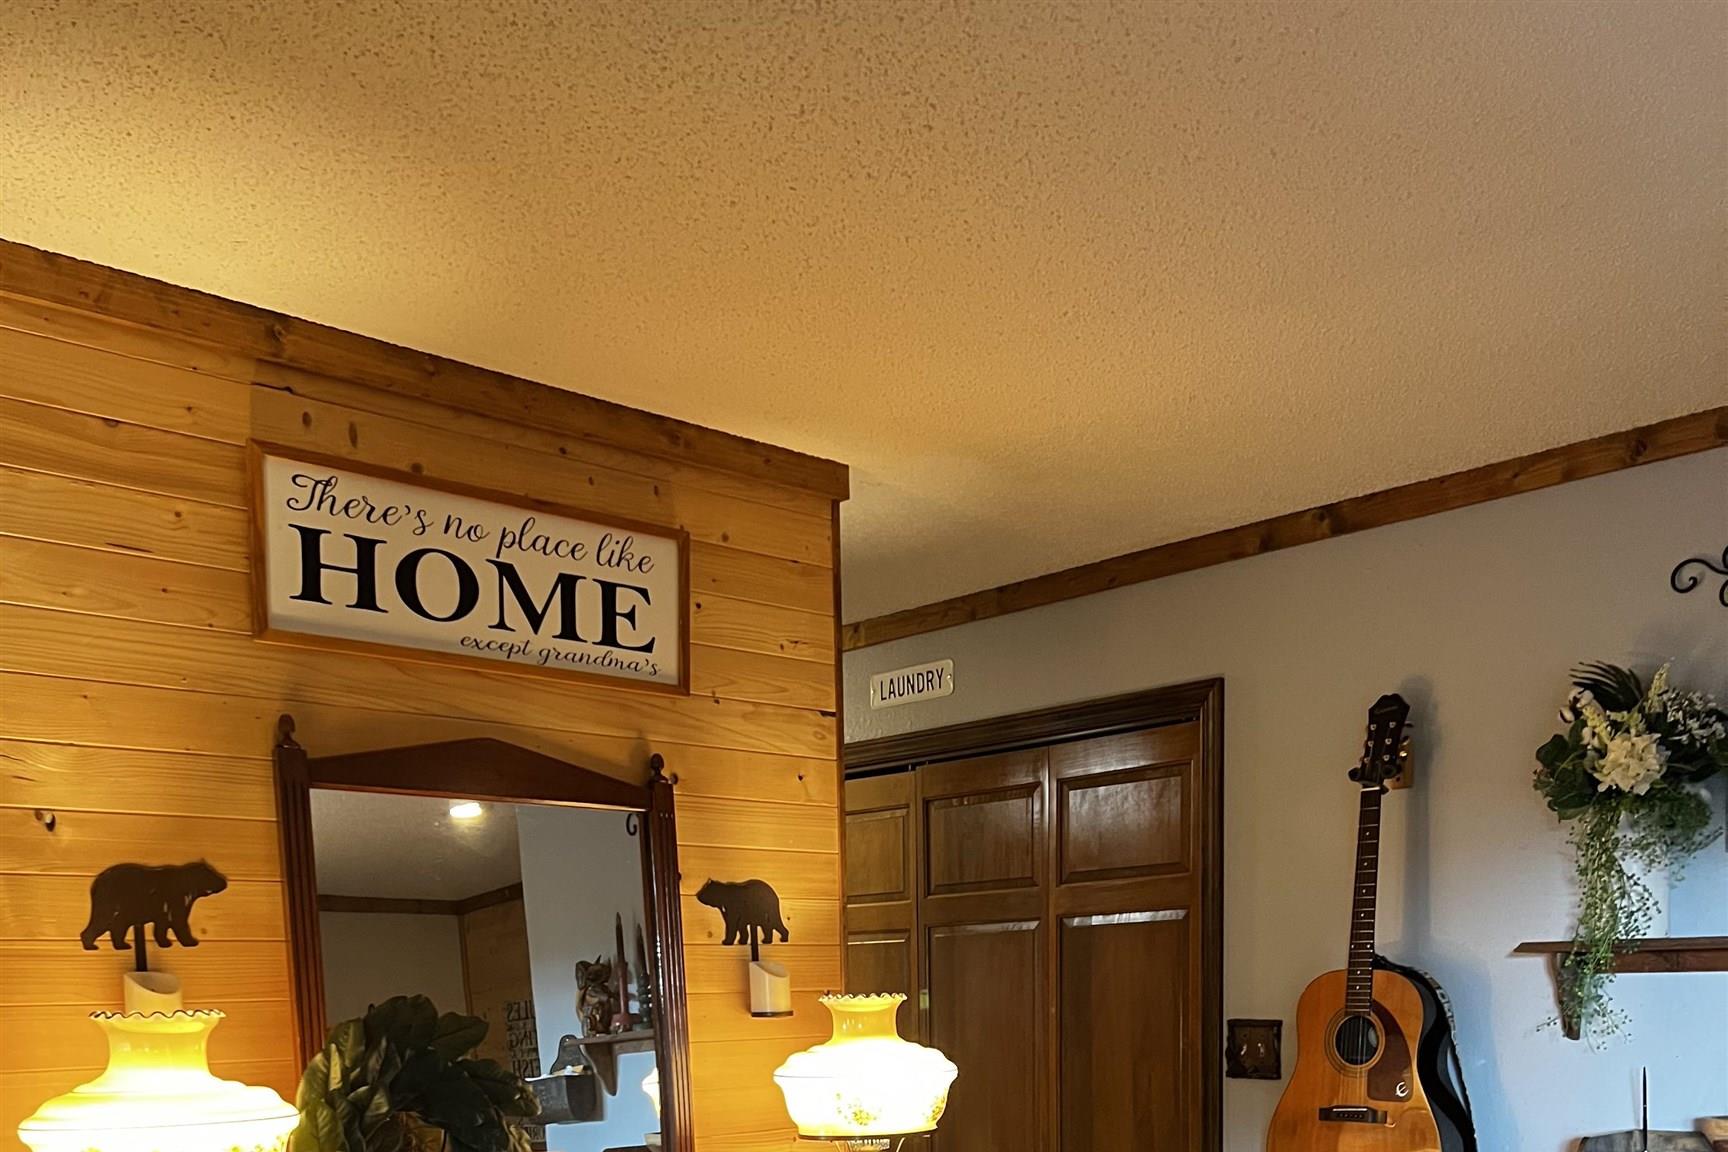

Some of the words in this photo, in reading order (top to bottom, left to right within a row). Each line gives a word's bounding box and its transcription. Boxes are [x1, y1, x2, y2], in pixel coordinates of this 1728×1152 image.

[286, 474, 434, 536] There's
[443, 516, 491, 542] no
[497, 517, 588, 561] place
[596, 532, 656, 574] like
[288, 523, 656, 654] HOME
[460, 635, 530, 661] except
[538, 646, 661, 677] grandma's
[880, 667, 944, 701] LAUNDRY
